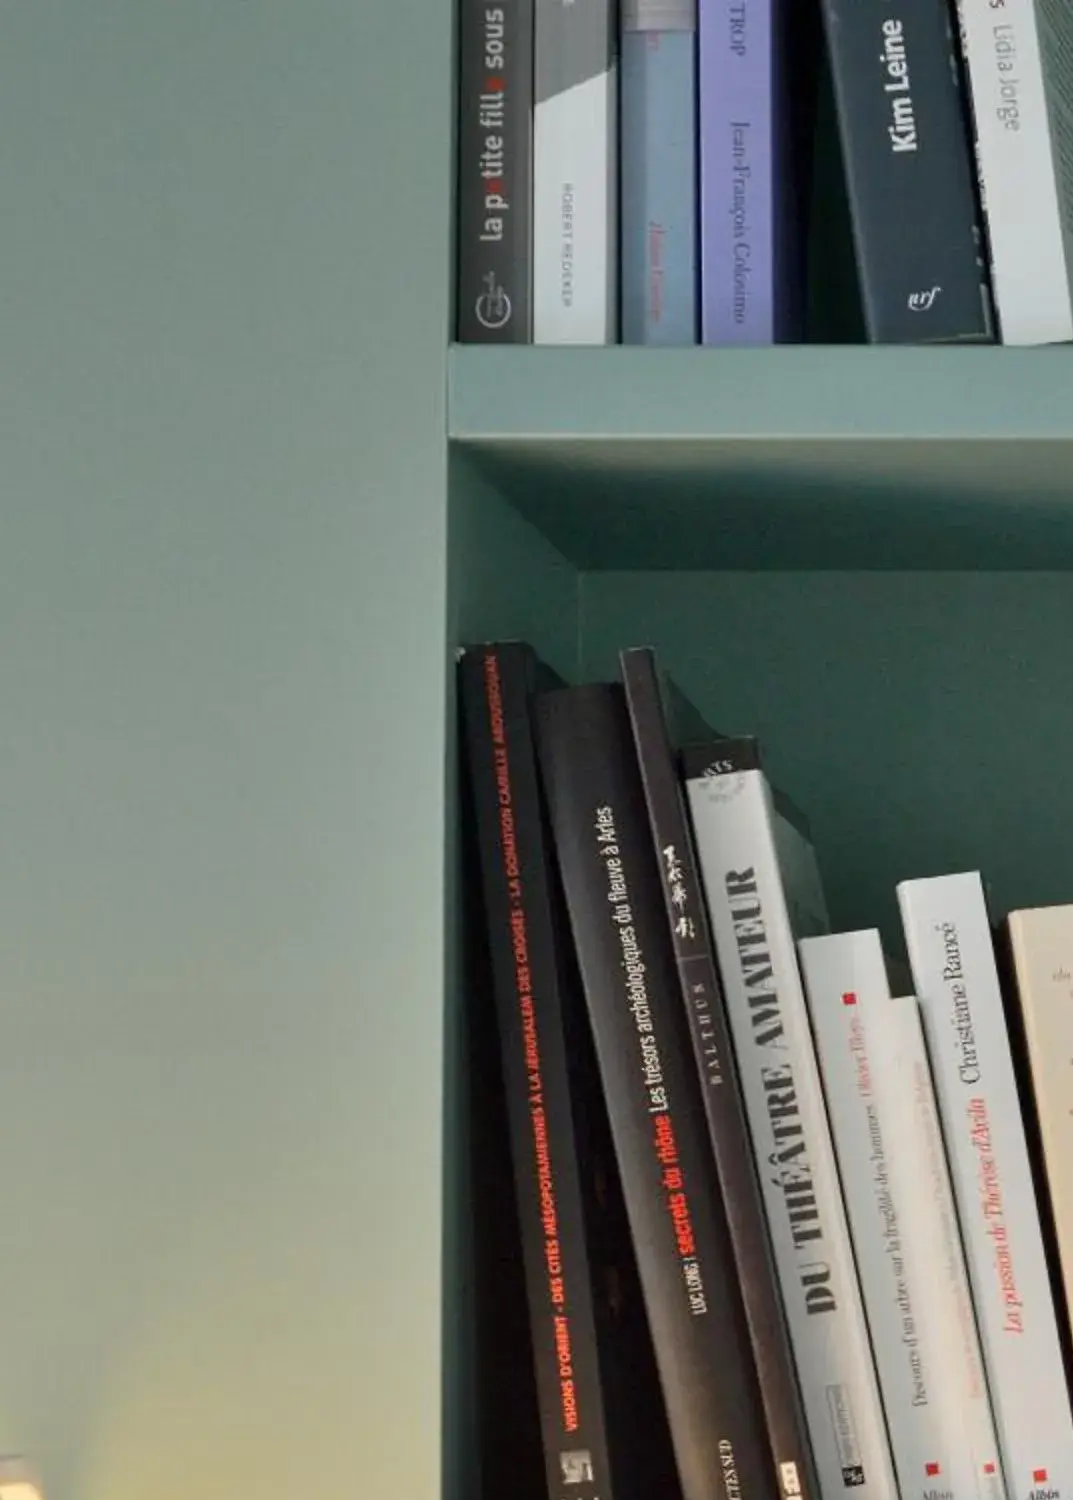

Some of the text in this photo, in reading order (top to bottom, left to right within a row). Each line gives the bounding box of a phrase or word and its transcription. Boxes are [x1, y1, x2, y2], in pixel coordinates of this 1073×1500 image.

[486, 9, 504, 68] sous
[730, 6, 745, 56] TROP
[880, 20, 916, 151] Kim Leine
[996, 78, 1019, 131] Jorge
[480, 218, 502, 240] la
[730, 122, 750, 323] Jean-François Colosimo
[495, 749, 510, 804] CAMILLE
[502, 808, 518, 876] DONATION
[509, 879, 520, 896] LA
[516, 967, 530, 992] DES
[936, 923, 980, 1084] Christiane Rancé
[595, 807, 707, 1314] LUC LONG secrets du rhône Les trésors archéologiques du fleuve à Arles
[693, 984, 722, 1084] BALTHUS
[528, 1073, 541, 1090] LA
[725, 867, 835, 1315] DU THÉÂTRE AMATEUR
[968, 1099, 1023, 1333] La passion de Thérèse d'Avila
[546, 1239, 560, 1274] CITÉS
[892, 1257, 903, 1276] sur
[550, 1278, 564, 1302] DES
[555, 1316, 572, 1376] D'ORIENT
[561, 1380, 577, 1430] VISIONS
[909, 1351, 927, 1406] Discours
[719, 1440, 733, 1466] SUD
